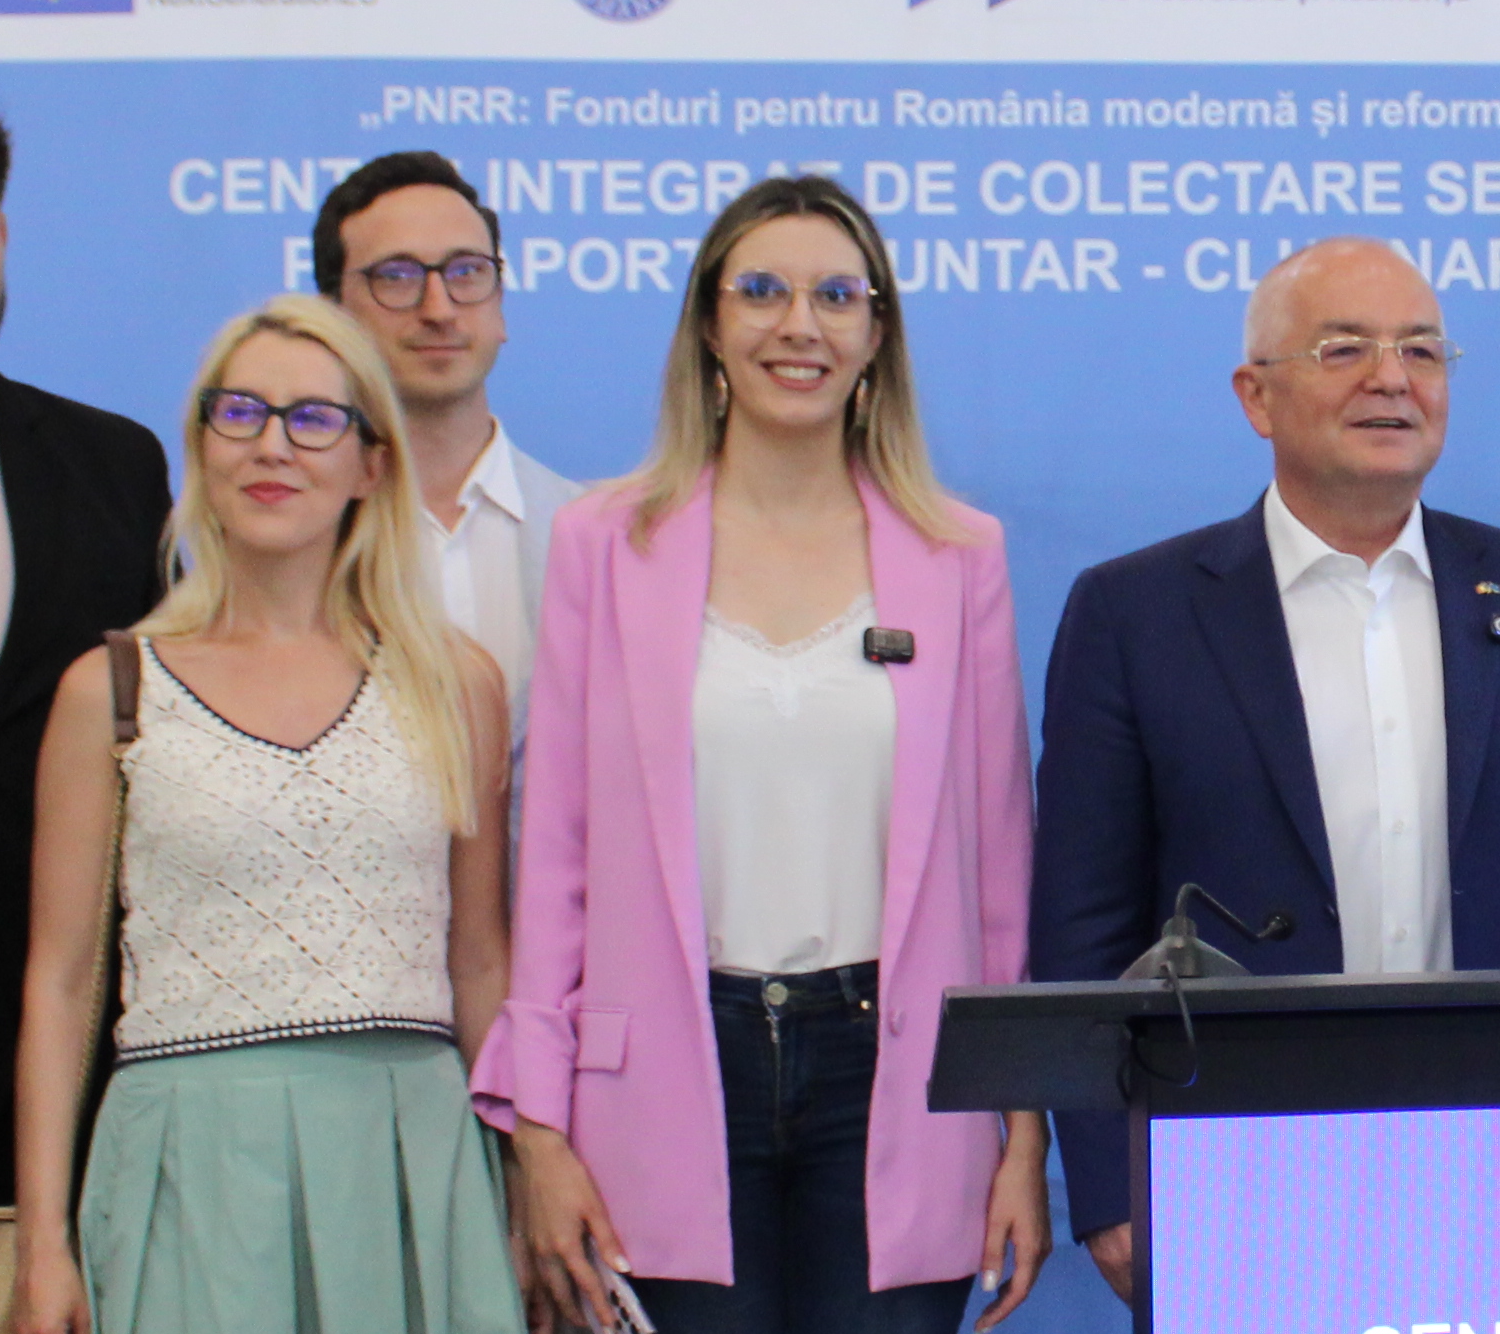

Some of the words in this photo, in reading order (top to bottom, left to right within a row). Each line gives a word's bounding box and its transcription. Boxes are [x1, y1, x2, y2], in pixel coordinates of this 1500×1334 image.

[546, 88, 719, 126] Fonduri
[735, 92, 879, 134] pentru
[894, 89, 1089, 128] România
[1105, 90, 1298, 128] modernă
[1312, 91, 1348, 138] și
[864, 160, 958, 215] DE
[979, 159, 1404, 215] COLECTARE
